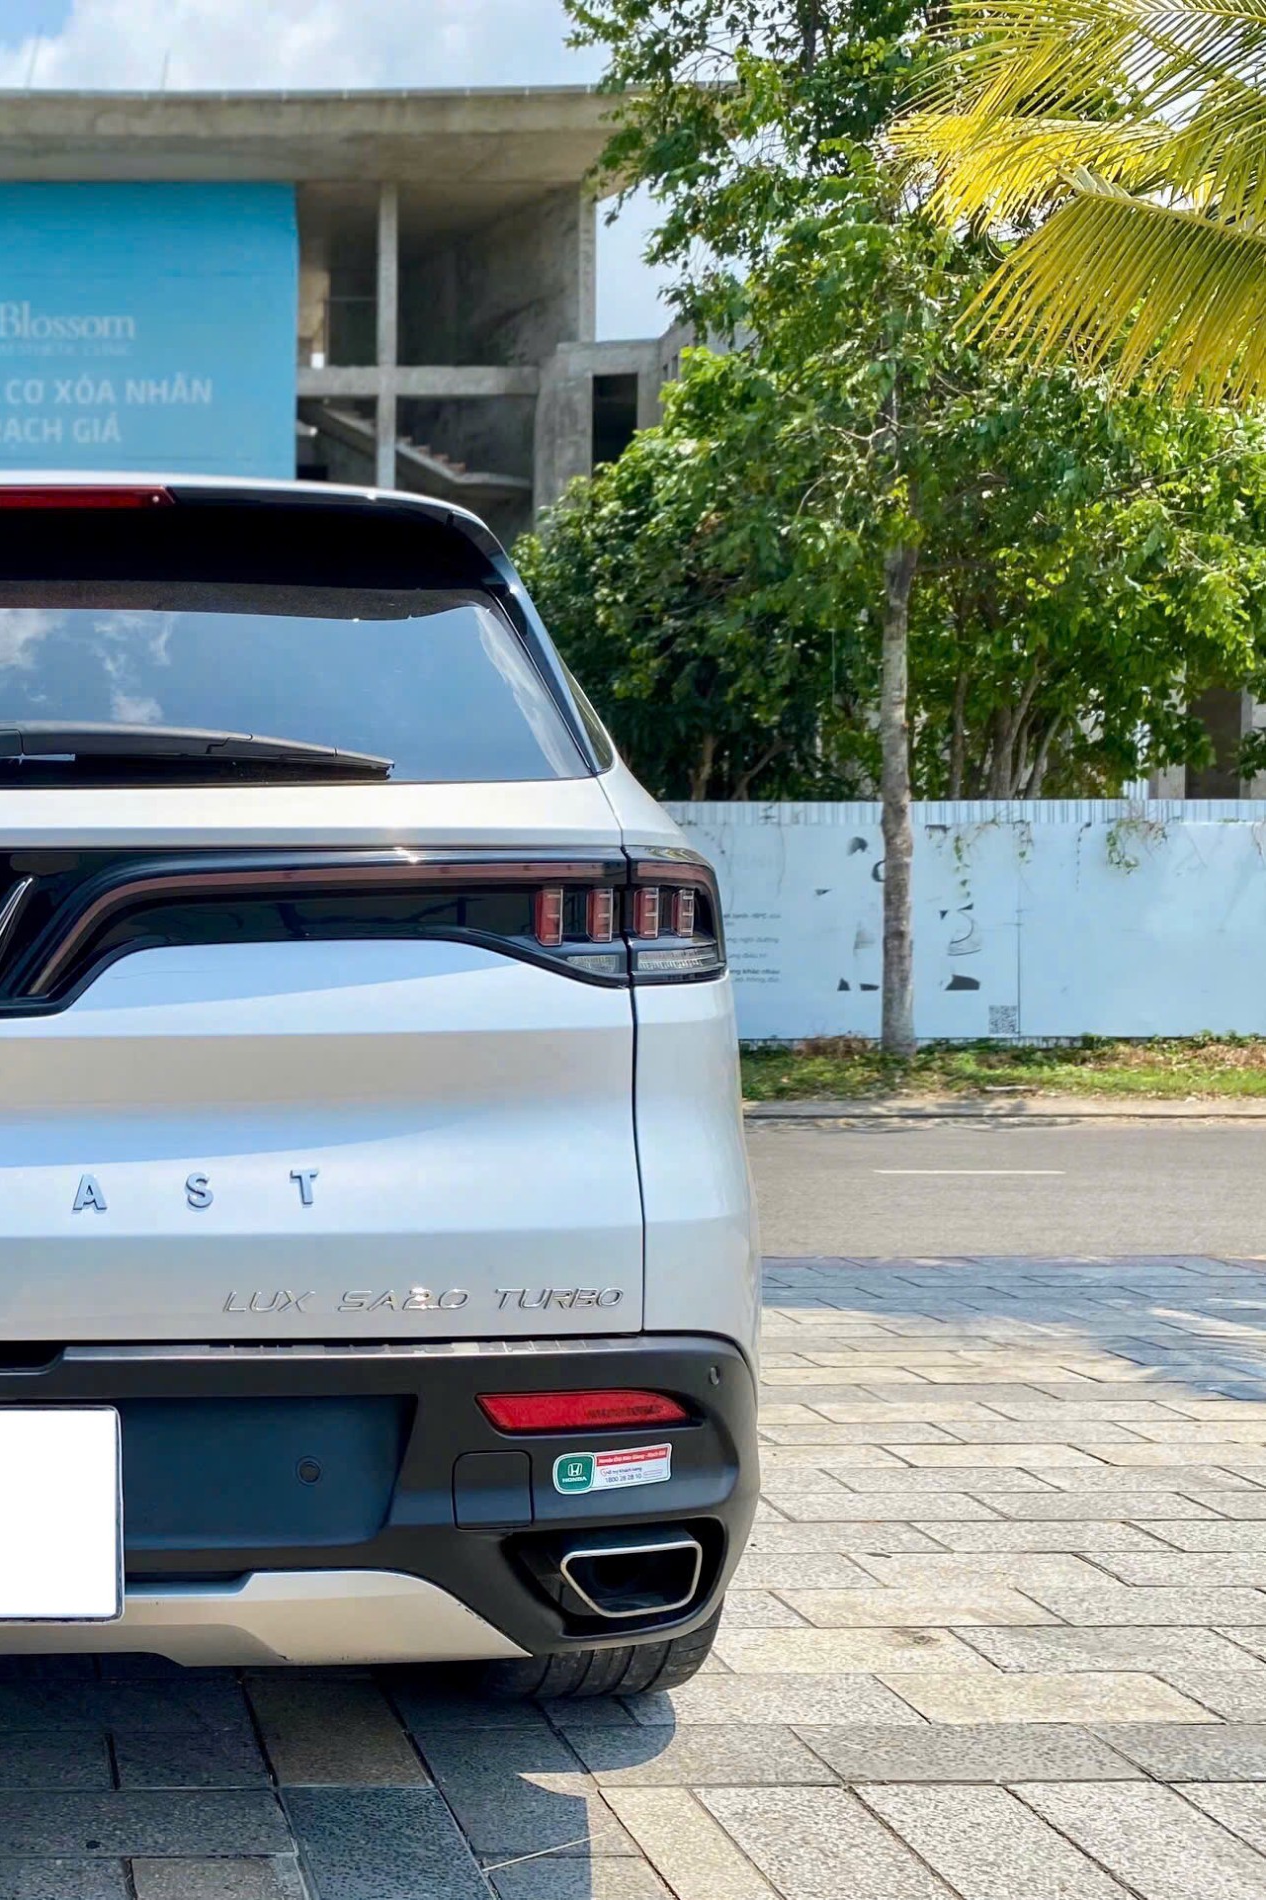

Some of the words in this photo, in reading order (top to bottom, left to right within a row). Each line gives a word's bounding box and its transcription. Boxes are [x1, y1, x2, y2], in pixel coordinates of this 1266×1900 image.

[53, 371, 117, 405] XÓA
[72, 411, 121, 444] GIÁ
[222, 1289, 316, 1313] LUX
[494, 1287, 625, 1311] TURBO
